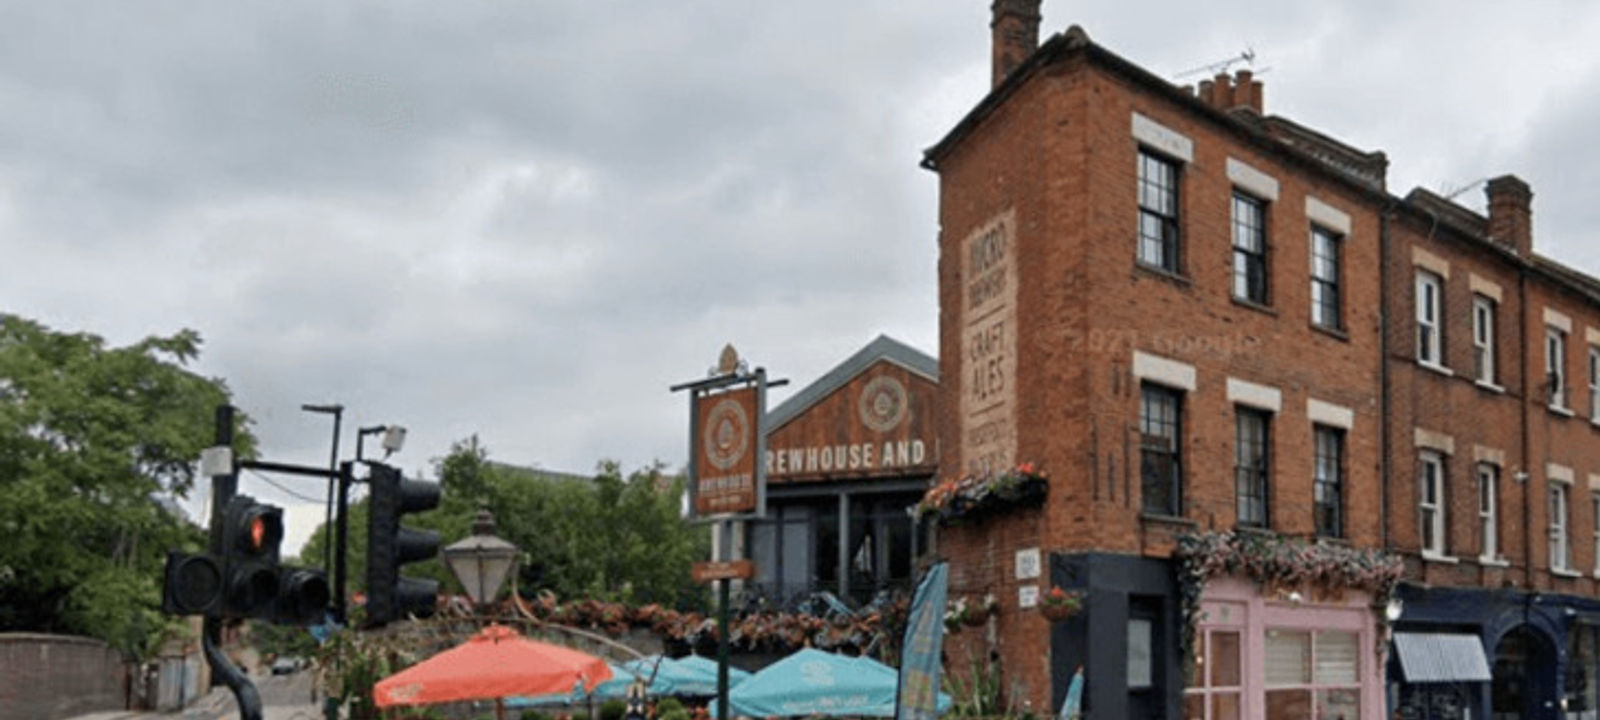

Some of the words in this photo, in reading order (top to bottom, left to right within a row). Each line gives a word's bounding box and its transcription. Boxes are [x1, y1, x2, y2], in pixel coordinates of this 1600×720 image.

[970, 319, 1004, 362] CRAFT
[971, 355, 1005, 401] ALES
[765, 442, 874, 474] REWHOUSE
[881, 440, 926, 465] AND
